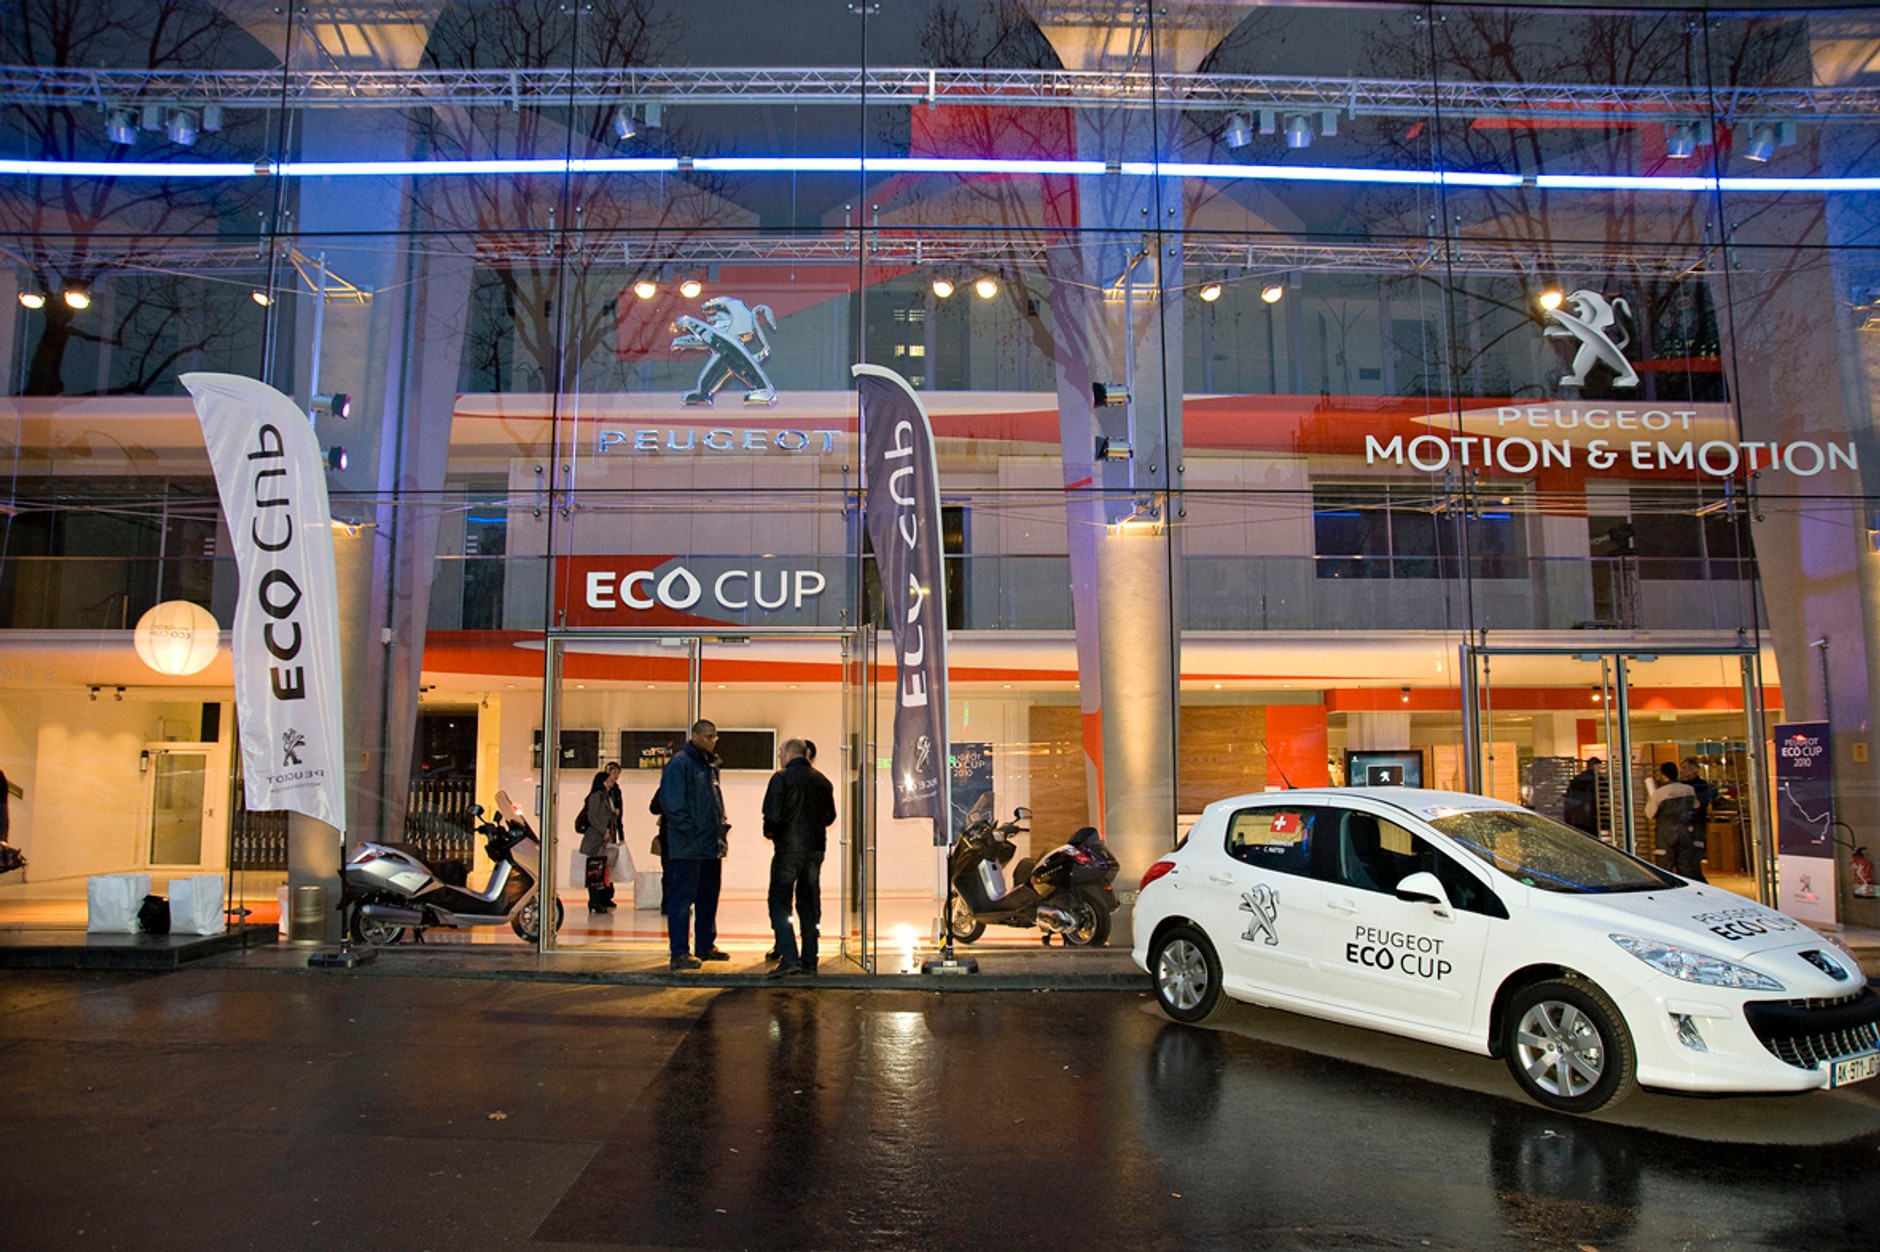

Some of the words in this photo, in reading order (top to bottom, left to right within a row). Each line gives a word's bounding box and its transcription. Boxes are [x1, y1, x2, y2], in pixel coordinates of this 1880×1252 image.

[1497, 406, 1697, 431] PEUGEOT
[598, 428, 843, 453] PEUGEOT
[1365, 433, 1573, 473] MOTION
[1586, 439, 1618, 470] &
[1629, 439, 1859, 477] EMOTION
[585, 565, 702, 610] ECO
[713, 569, 827, 610] CUP
[963, 759, 986, 769] CUP
[1781, 745, 1802, 758] ECO
[1802, 745, 1823, 757] CUP
[1793, 757, 1812, 768] 2010
[953, 769, 974, 778] 2010
[1354, 925, 1445, 955] PEUGEOT
[1709, 919, 1768, 941] ECO
[1346, 942, 1395, 970] ECO
[1400, 953, 1453, 981] CUP
